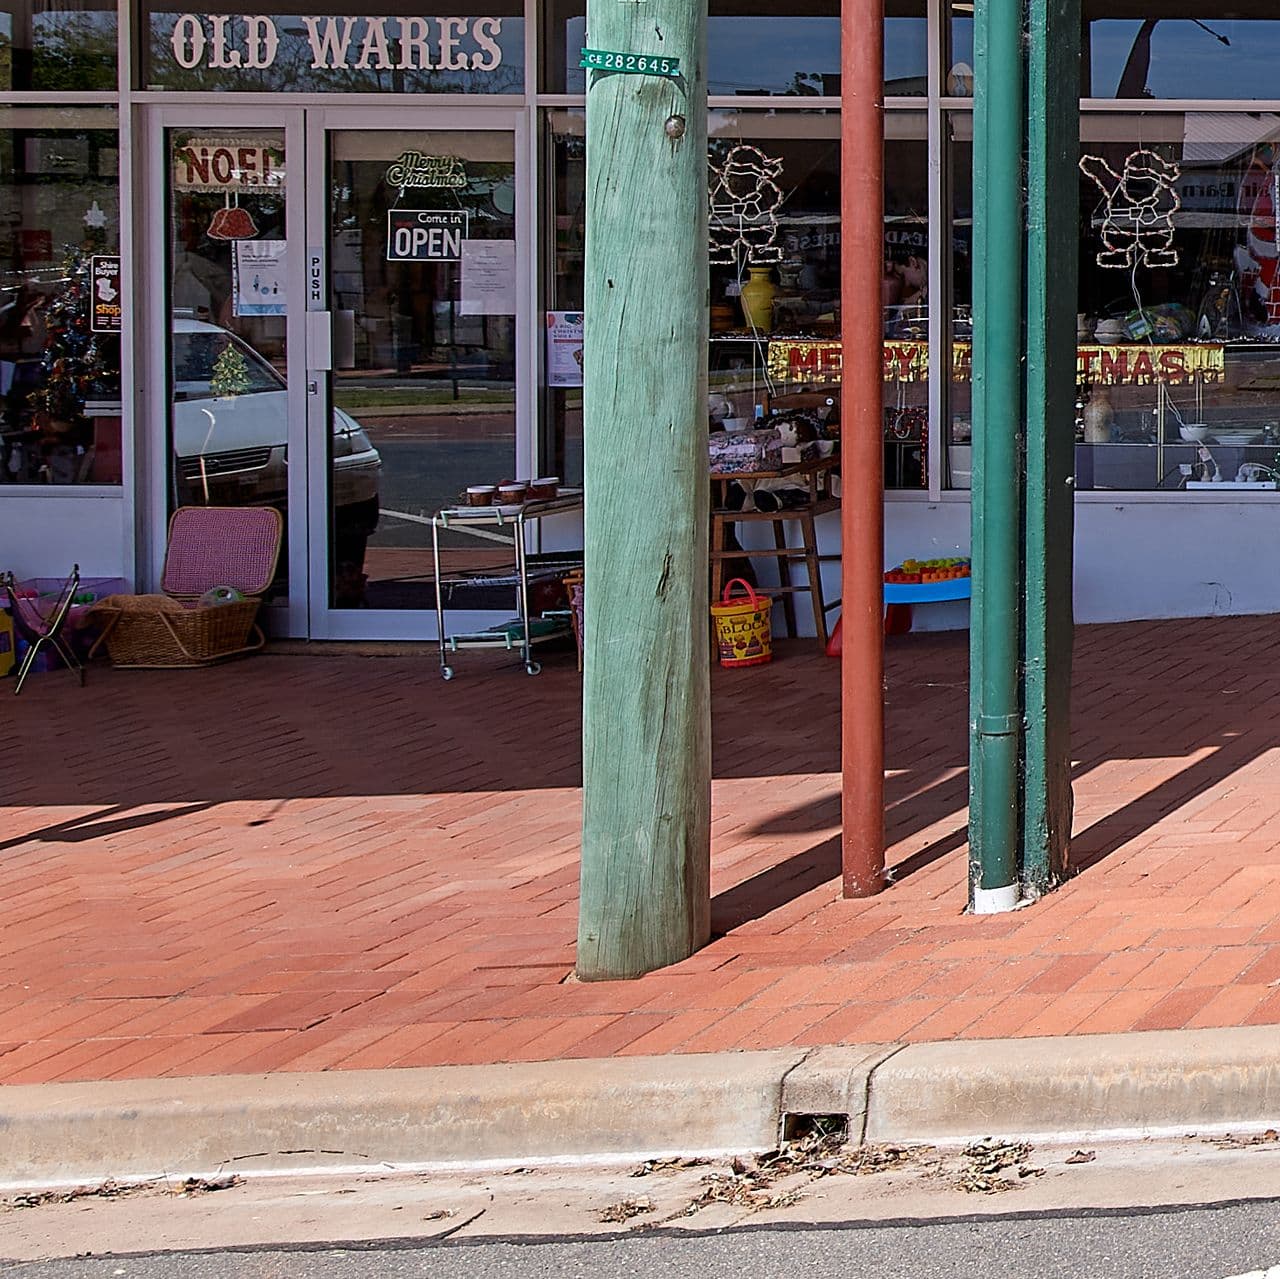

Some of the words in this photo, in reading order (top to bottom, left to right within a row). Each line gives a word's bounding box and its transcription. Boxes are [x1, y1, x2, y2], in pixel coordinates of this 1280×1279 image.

[173, 15, 280, 70] OLD
[301, 16, 503, 72] WARES
[604, 53, 670, 73] 282645
[398, 151, 456, 174] Merry
[386, 164, 467, 188] Christmas
[417, 212, 448, 224] Come
[450, 211, 463, 224] in
[394, 227, 461, 257] OPEN
[311, 257, 320, 300] PUSH
[95, 304, 121, 317] Shop
